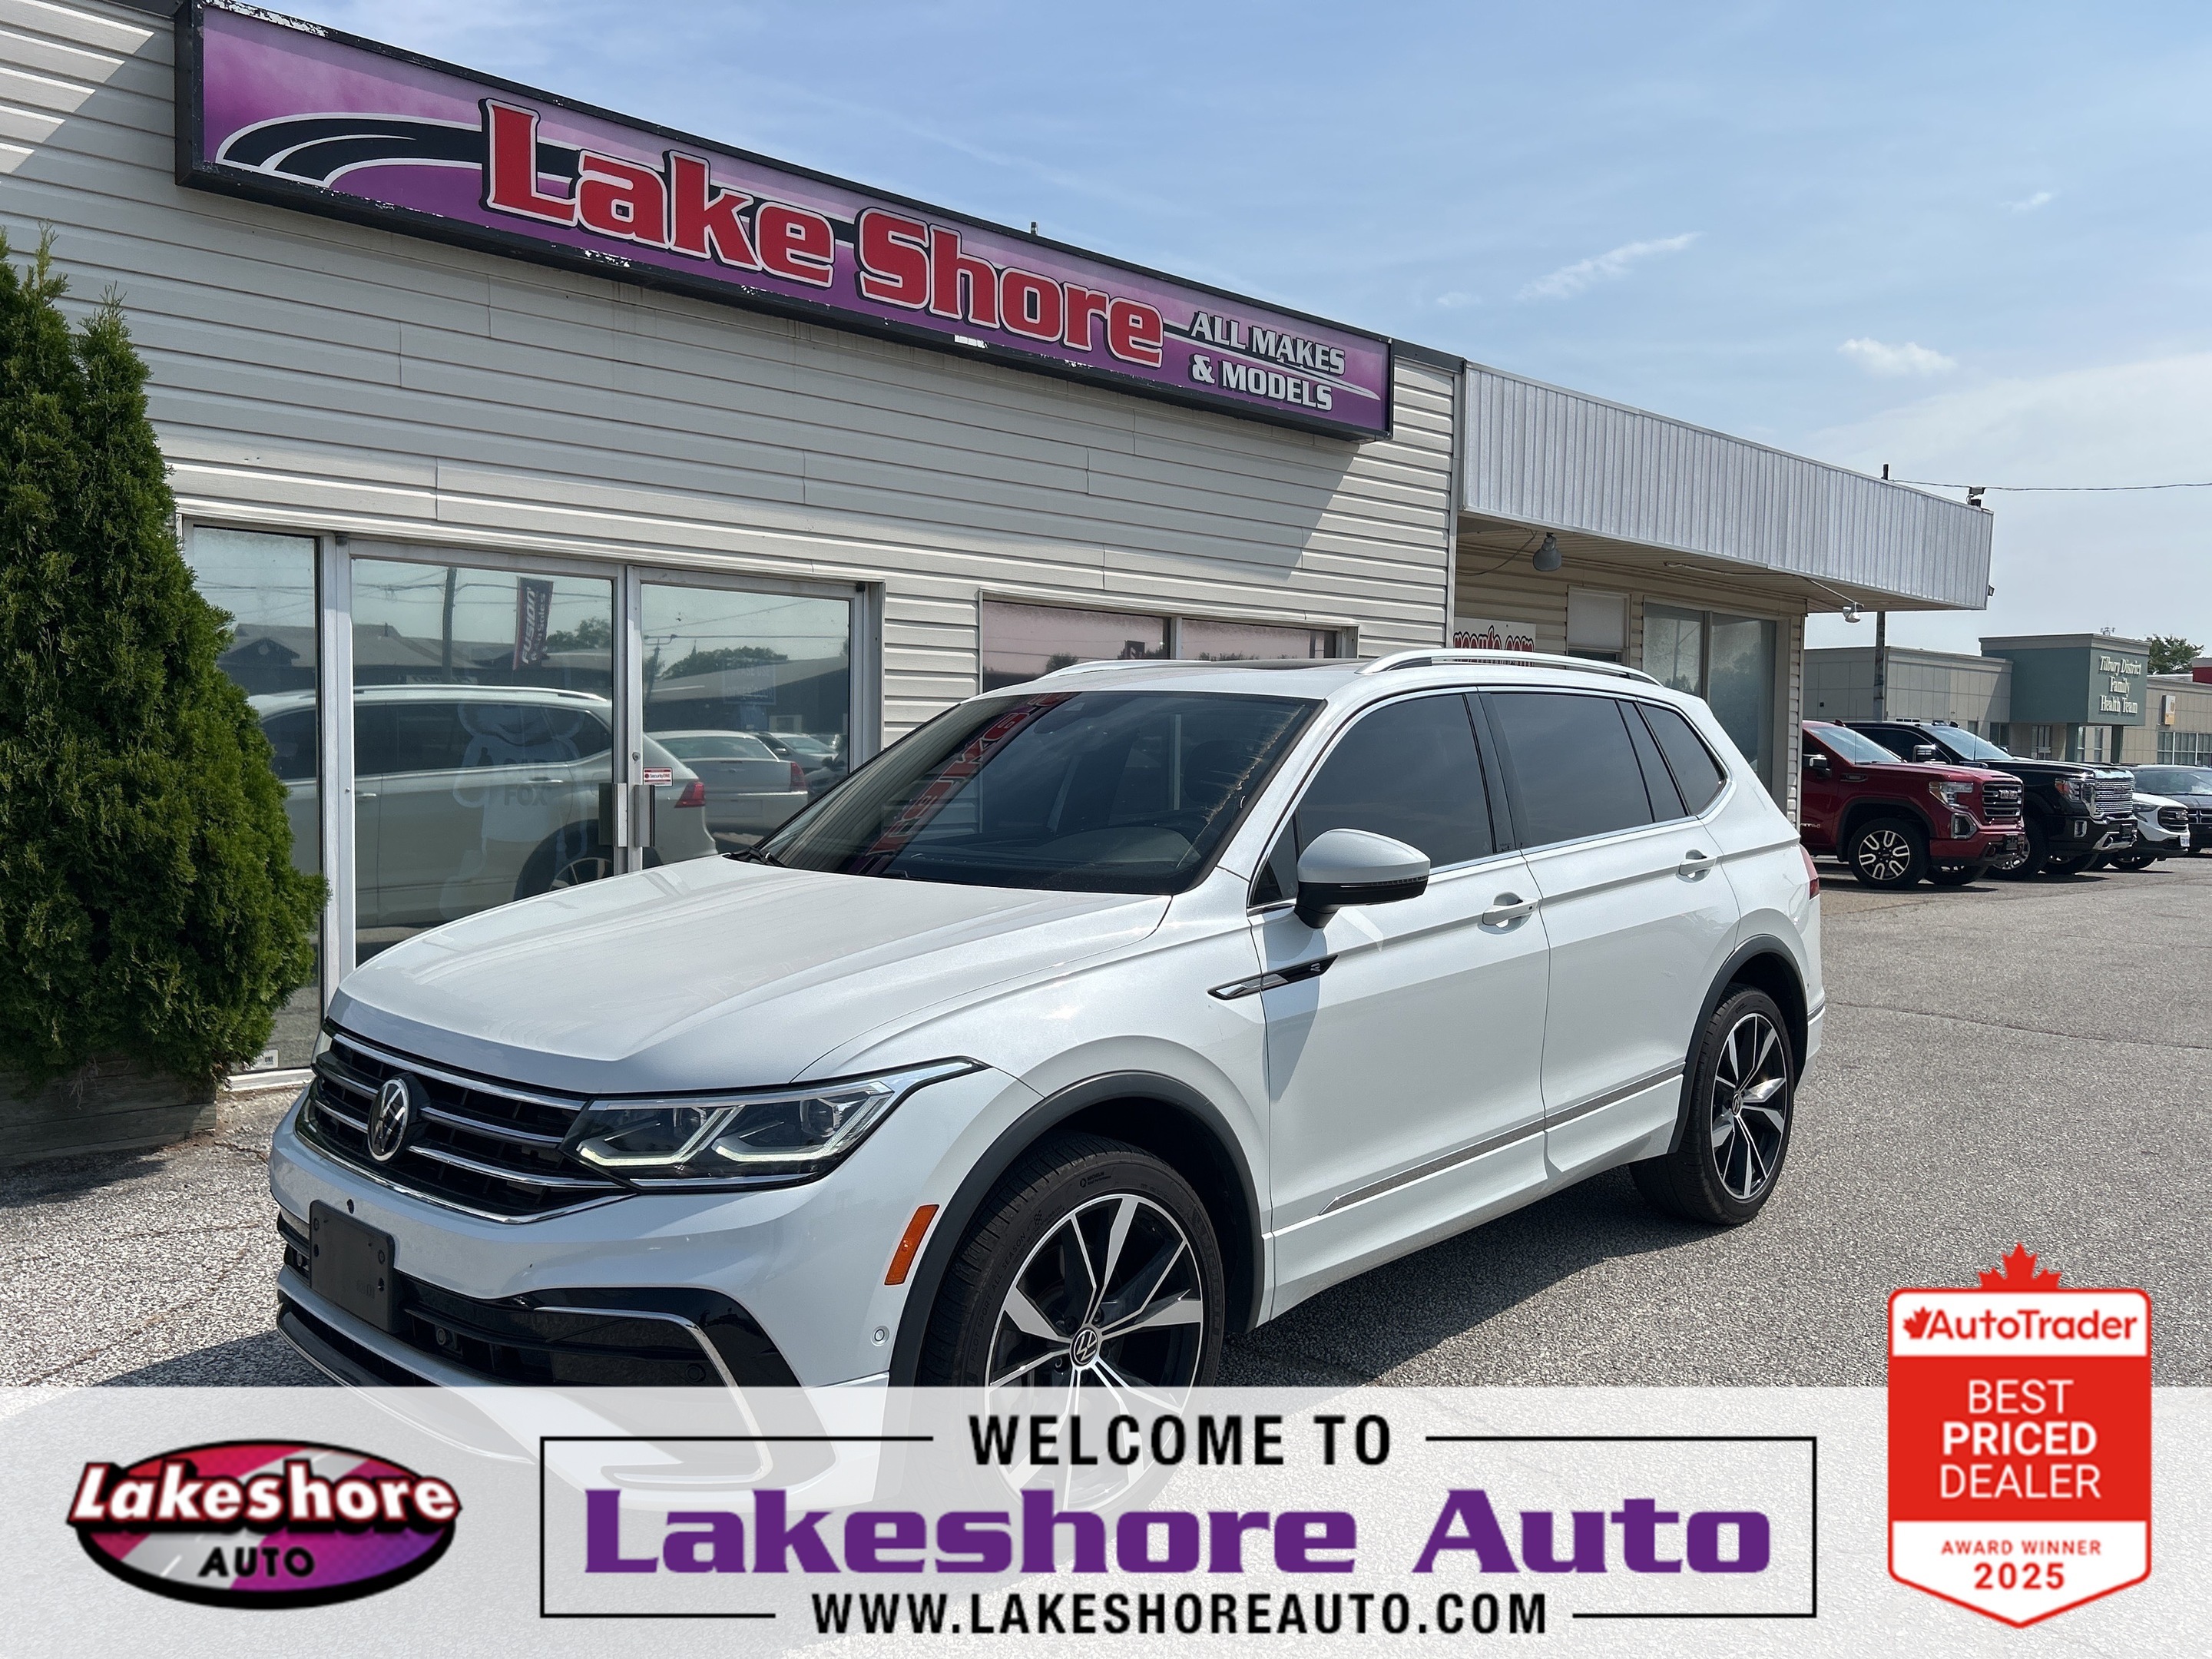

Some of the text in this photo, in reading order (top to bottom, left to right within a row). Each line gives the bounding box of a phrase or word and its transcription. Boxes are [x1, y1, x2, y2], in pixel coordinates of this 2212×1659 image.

[479, 98, 1165, 368] Lake Shore
[1190, 311, 1345, 375] ALL MAKES
[1190, 353, 1333, 411] & MODELS
[2100, 656, 2142, 676] Tilbury District
[2109, 677, 2131, 696] Family
[2100, 695, 2138, 714] Health Team
[969, 1231, 1026, 1363] PILOT SPORT ALL SEASON
